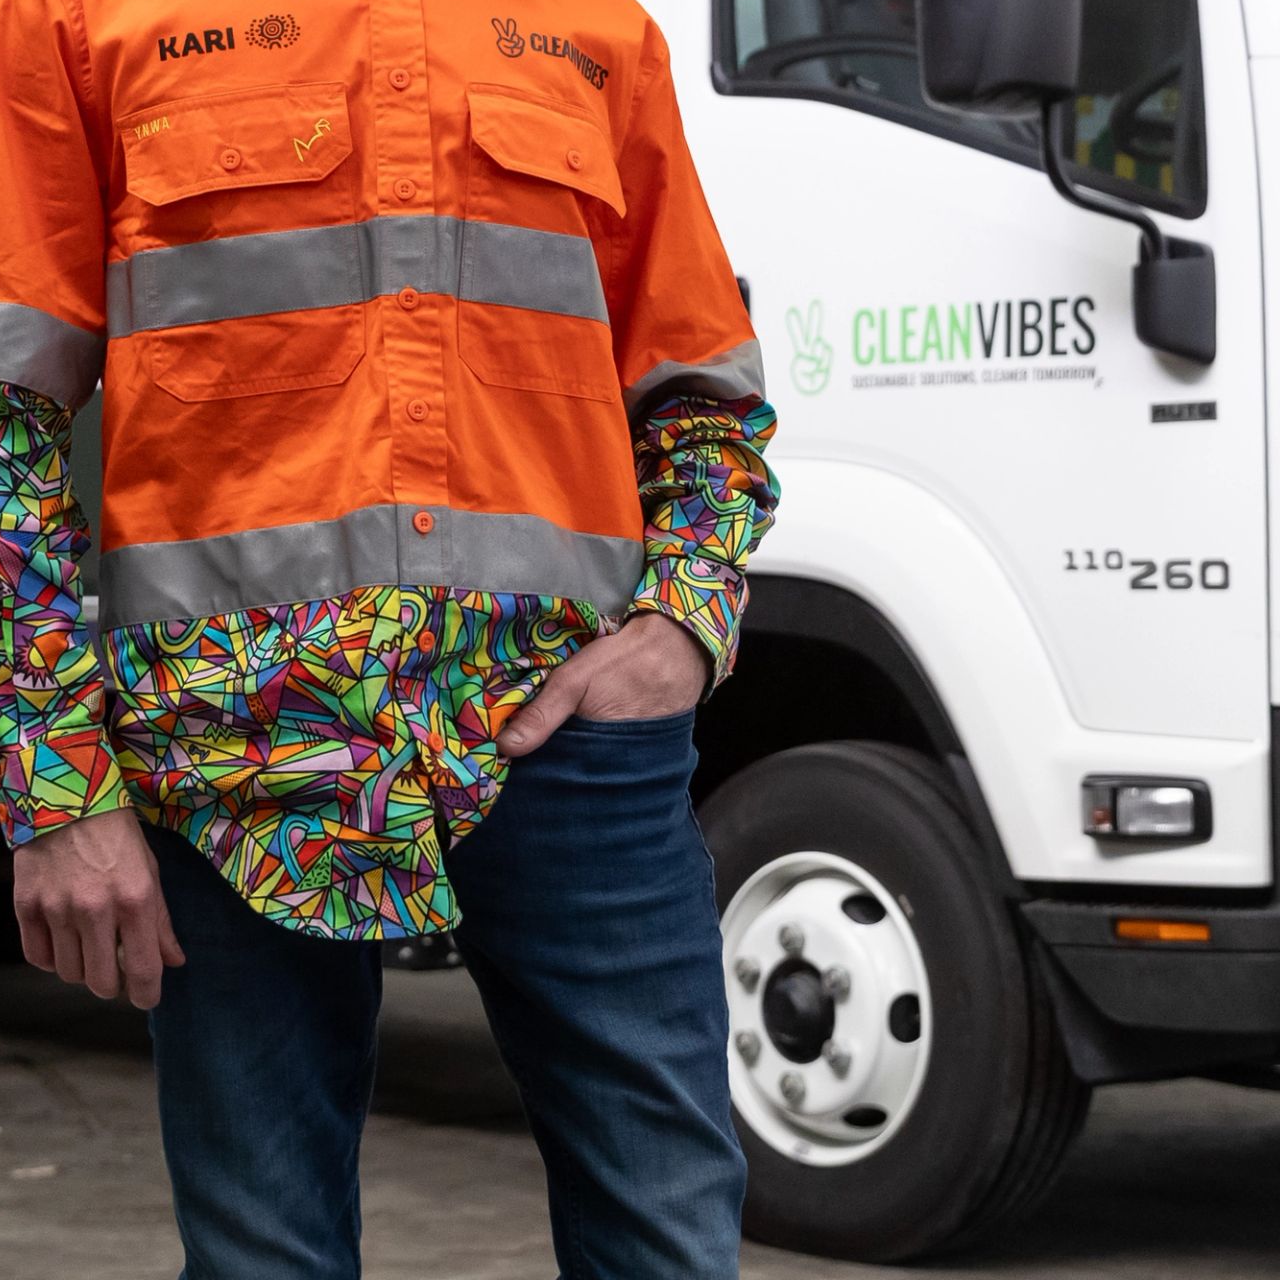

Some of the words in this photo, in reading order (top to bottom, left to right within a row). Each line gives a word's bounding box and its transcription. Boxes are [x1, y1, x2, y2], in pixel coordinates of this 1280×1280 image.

[158, 27, 235, 61] KARI
[530, 33, 608, 90] CLEANVIBES
[852, 295, 1097, 367] CLEANVIBES
[1064, 550, 1123, 571] 110
[1129, 559, 1231, 591] 260
